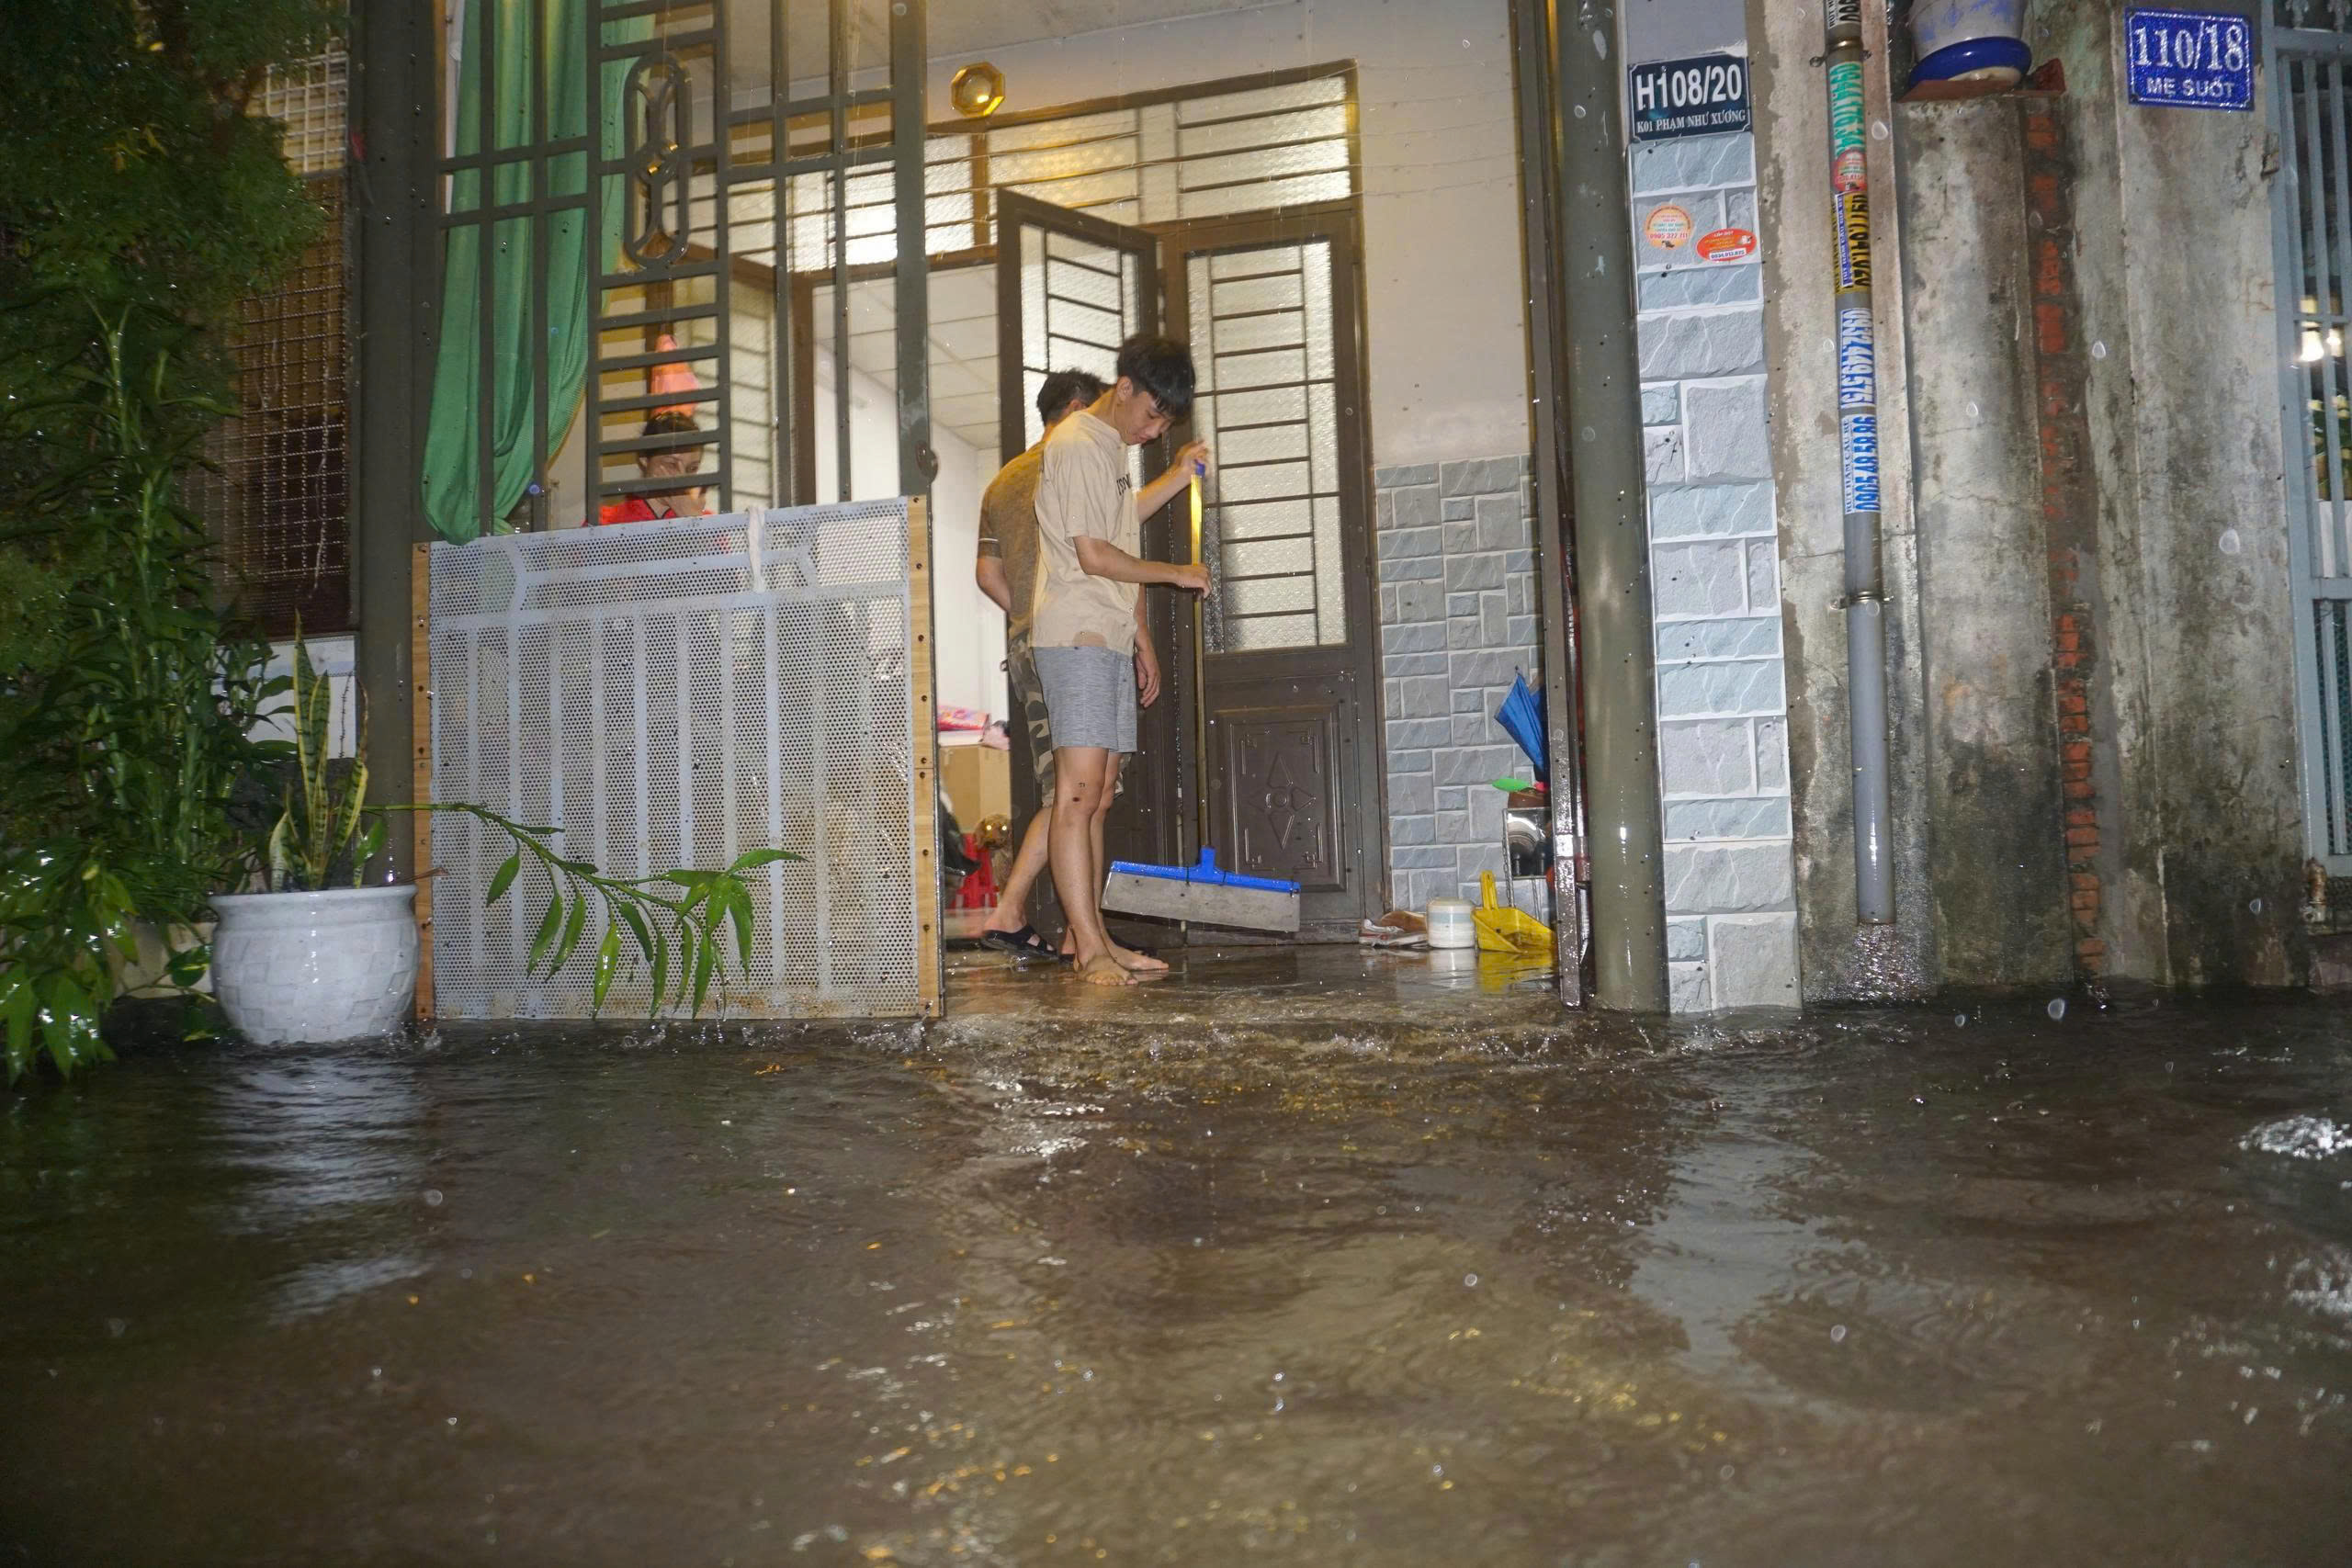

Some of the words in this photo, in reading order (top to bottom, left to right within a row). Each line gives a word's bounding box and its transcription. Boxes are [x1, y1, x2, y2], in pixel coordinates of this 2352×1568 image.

[2133, 20, 2244, 73] 110/18
[1636, 63, 1742, 110] H108/20
[2146, 77, 2177, 97] MẸ
[1637, 120, 1654, 133] K01
[1656, 116, 1685, 131] PHẠM
[1687, 111, 1710, 127] NHƯ
[1711, 107, 1746, 125] XƯƠNG
